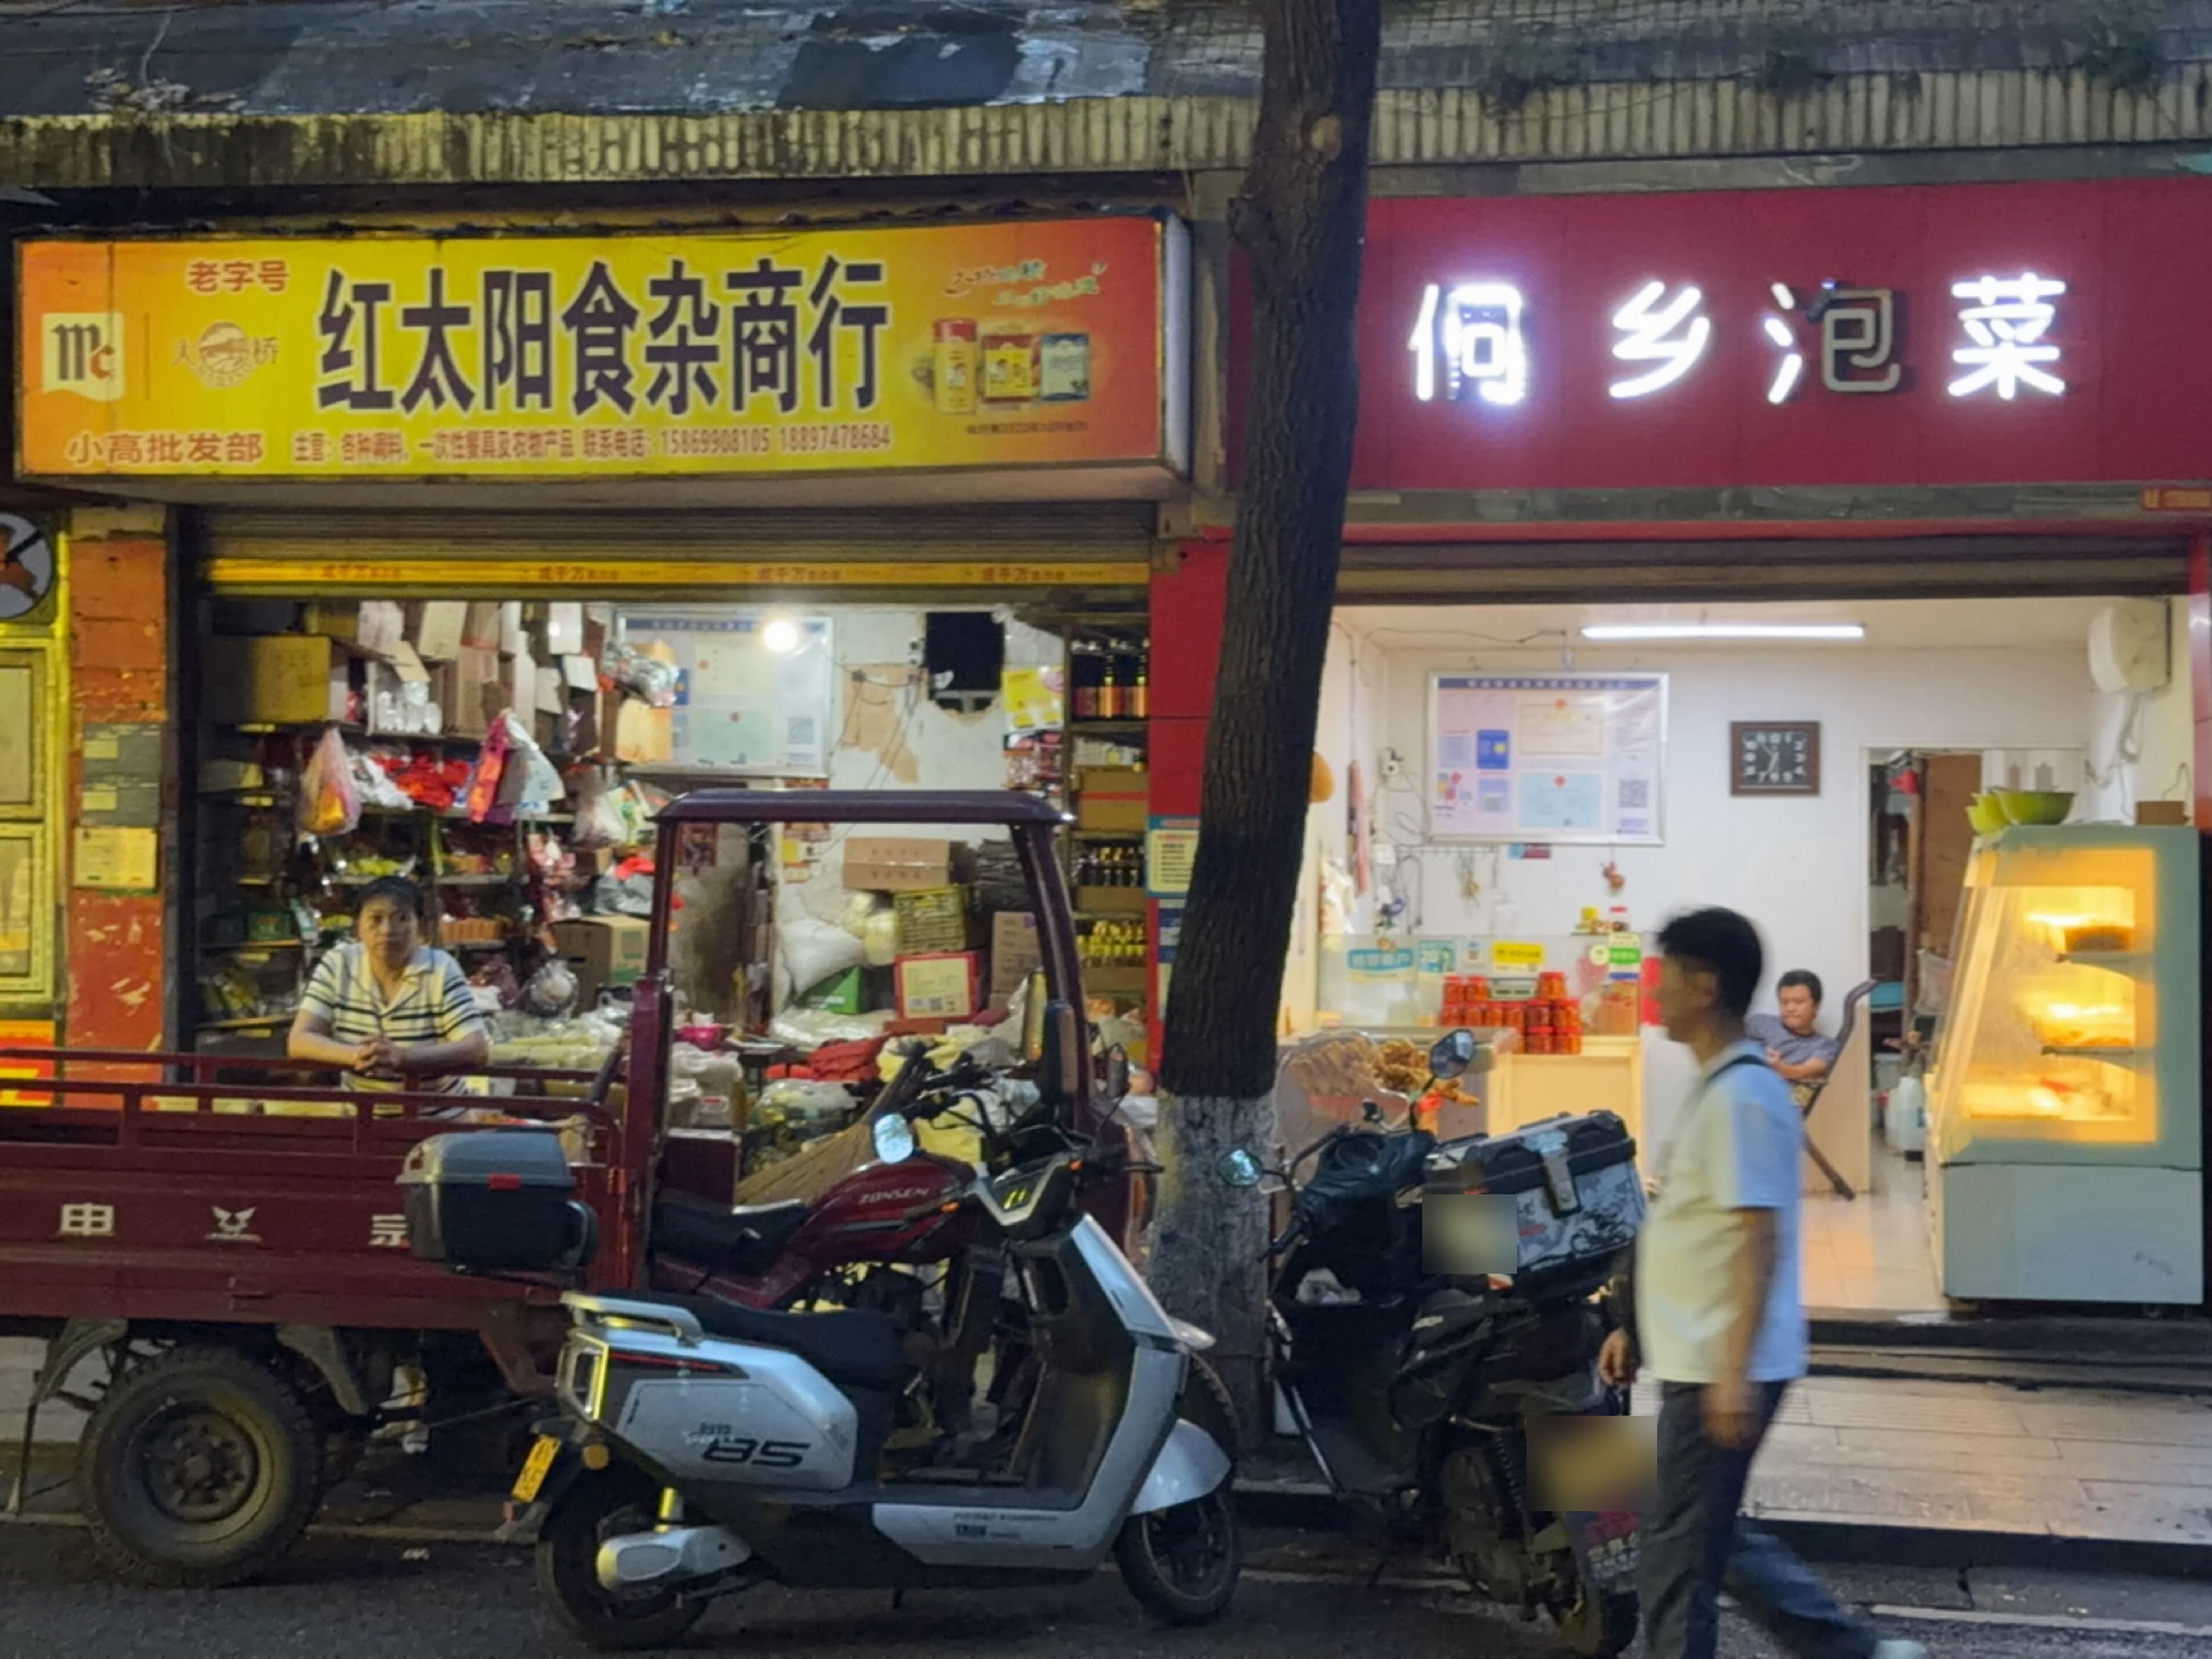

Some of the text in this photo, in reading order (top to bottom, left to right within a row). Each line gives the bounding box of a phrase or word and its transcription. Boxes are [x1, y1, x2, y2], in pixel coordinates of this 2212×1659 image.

[188, 259, 288, 293] 老字号
[317, 256, 889, 415] 红太阳食杂商行
[1408, 274, 2067, 405] 侗乡泡菜
[67, 431, 264, 466] 小高批发部
[60, 1203, 115, 1238] 申
